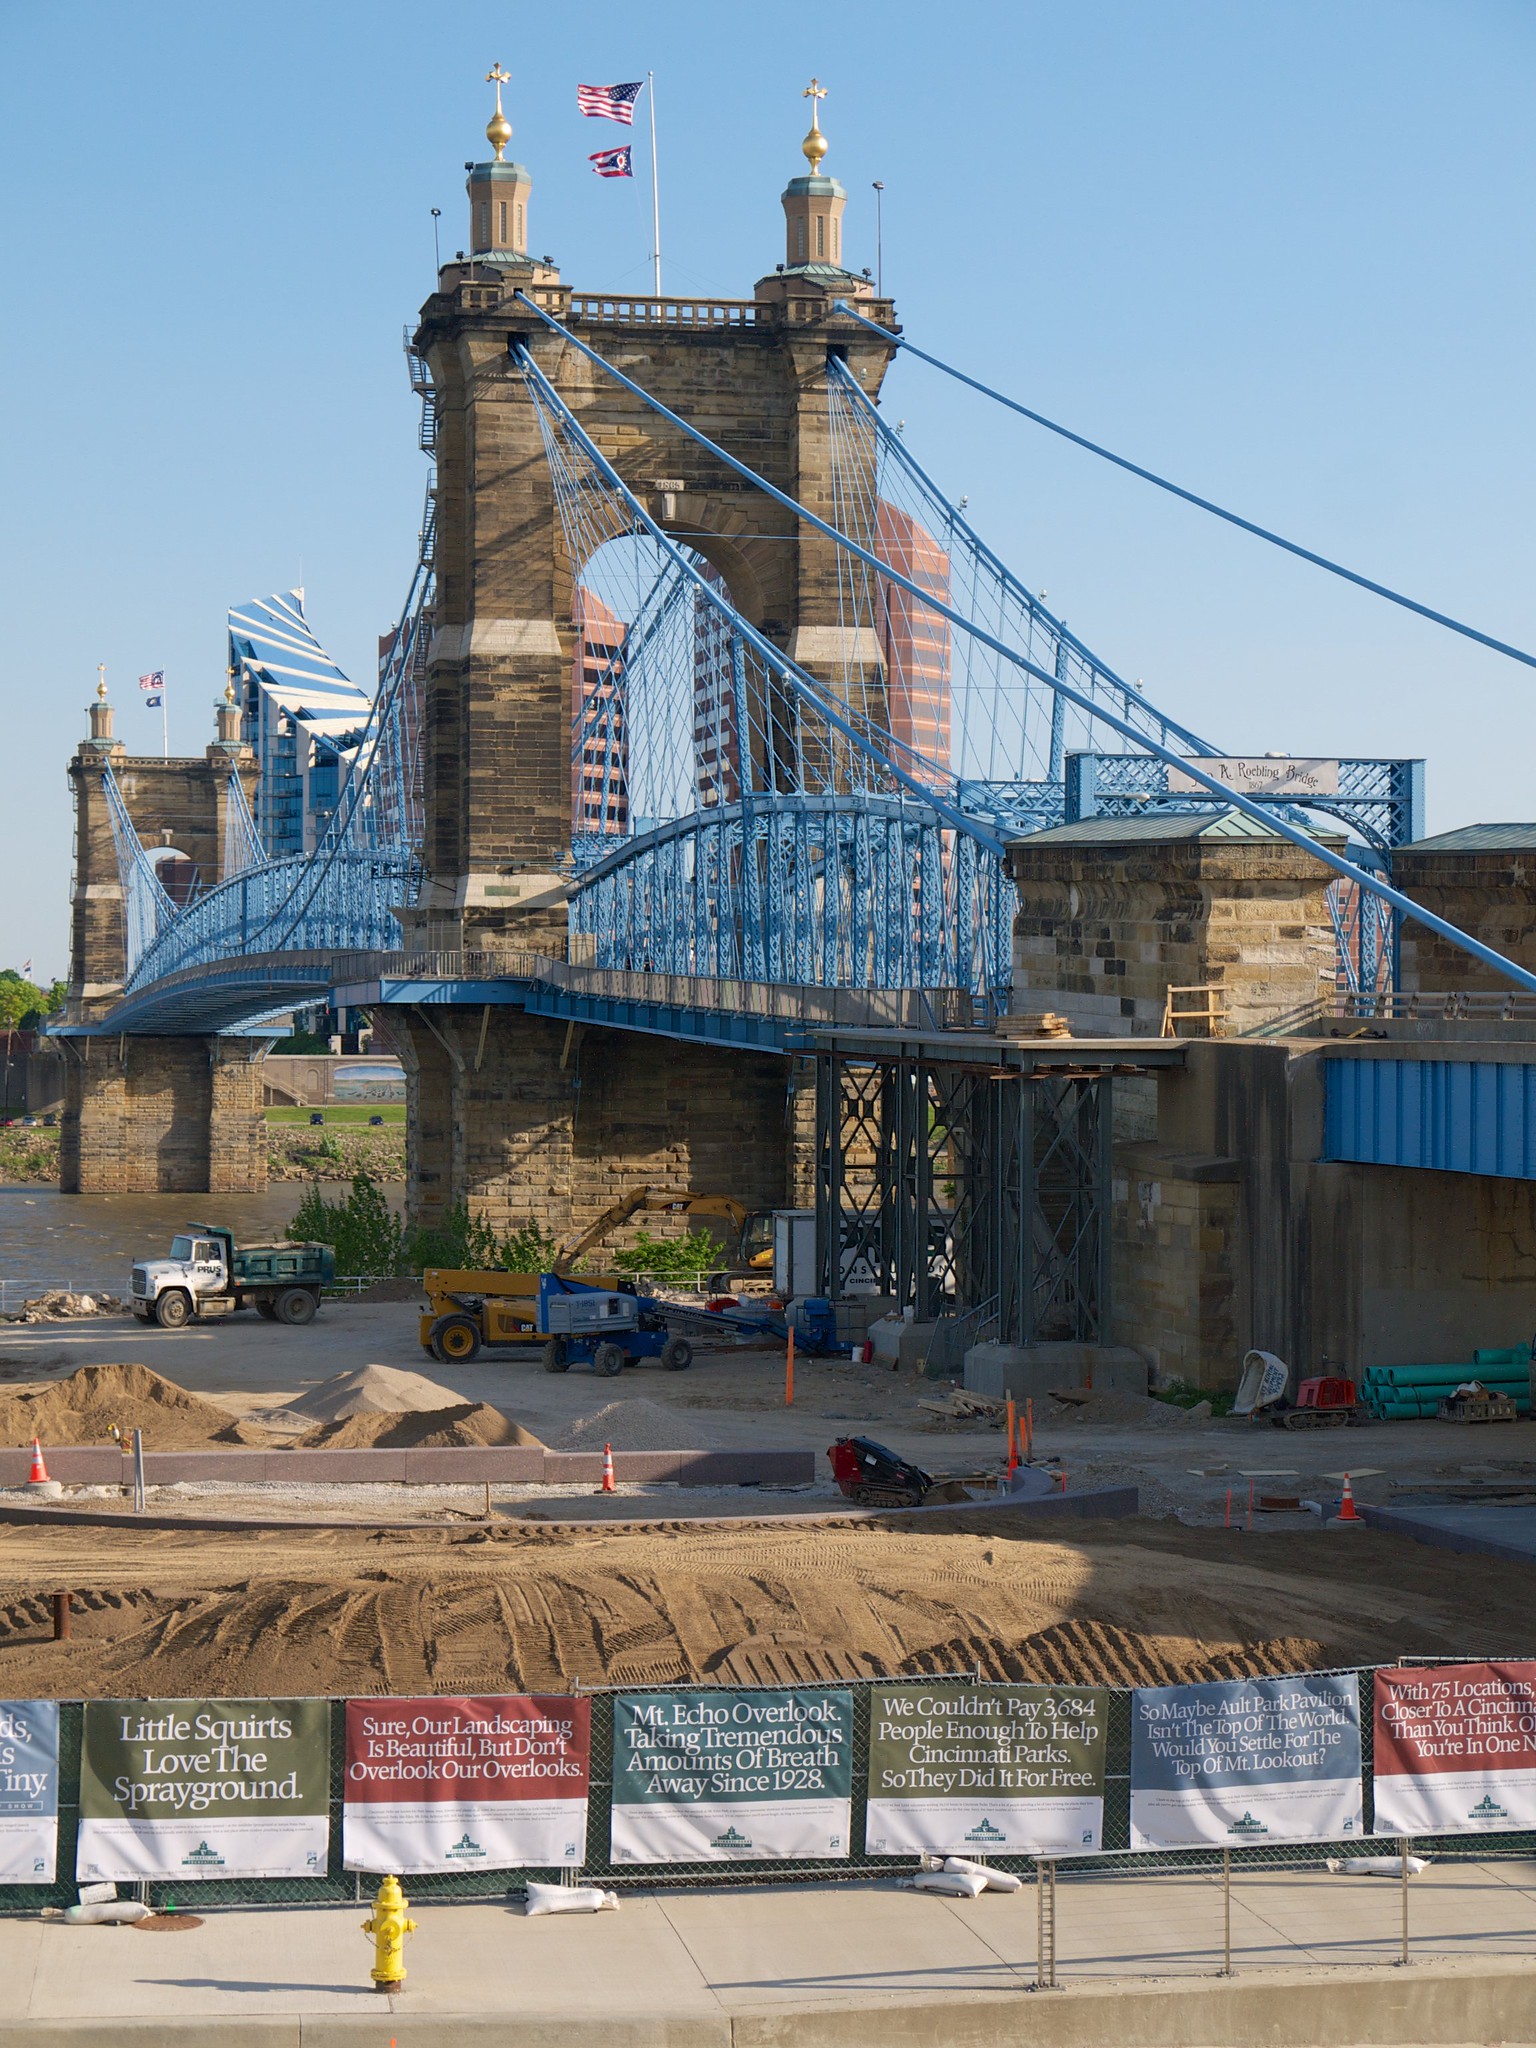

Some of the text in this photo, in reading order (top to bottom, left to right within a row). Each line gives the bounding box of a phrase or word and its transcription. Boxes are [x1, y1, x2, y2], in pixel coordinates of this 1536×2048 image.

[1238, 762, 1280, 781] Roebling
[1286, 764, 1319, 789] Bridge
[1248, 781, 1263, 790] 1867
[197, 1265, 222, 1274] PRUS
[520, 1323, 533, 1332] CAT
[1388, 1678, 1535, 1701] With 75 Locations,
[631, 1699, 842, 1726] Mt. Echo Overlook.
[883, 1696, 1096, 1722] We Couldn't Pay 3,684
[1139, 1690, 1353, 1723] So Maybe Ault Park Pavilion
[1381, 1701, 1433, 1720] Closer
[1432, 1700, 1451, 1718] To
[1452, 1699, 1467, 1717] A
[119, 1713, 293, 1749] Little Squirts
[363, 1714, 573, 1740] Sure, Our Landscaping
[878, 1720, 1099, 1746] People Enough To Help
[1147, 1708, 1350, 1739] Isn't The Top Of The World.
[1390, 1720, 1433, 1739] Than
[1432, 1719, 1464, 1737] You
[1464, 1715, 1518, 1736] Think.
[367, 1737, 567, 1760] Is Beautiful, But Don't
[624, 1721, 842, 1755] Taking Tremendous
[1152, 1728, 1341, 1758] Would You Settle For The
[1414, 1738, 1464, 1758] You're
[1465, 1737, 1484, 1755] In
[1485, 1735, 1521, 1754] One
[142, 1746, 268, 1775] Love The
[625, 1745, 840, 1772] Amounts Of Breath
[909, 1744, 1072, 1764] Cincinnati Parks.
[1172, 1748, 1326, 1779] Top Of Mt. Lookout?
[350, 1758, 584, 1781] Overlook Our Overlooks.
[881, 1767, 1096, 1793] So They Did It For Free.
[113, 1772, 303, 1810] Sprayground.
[644, 1768, 825, 1799] Away Since 1928.
